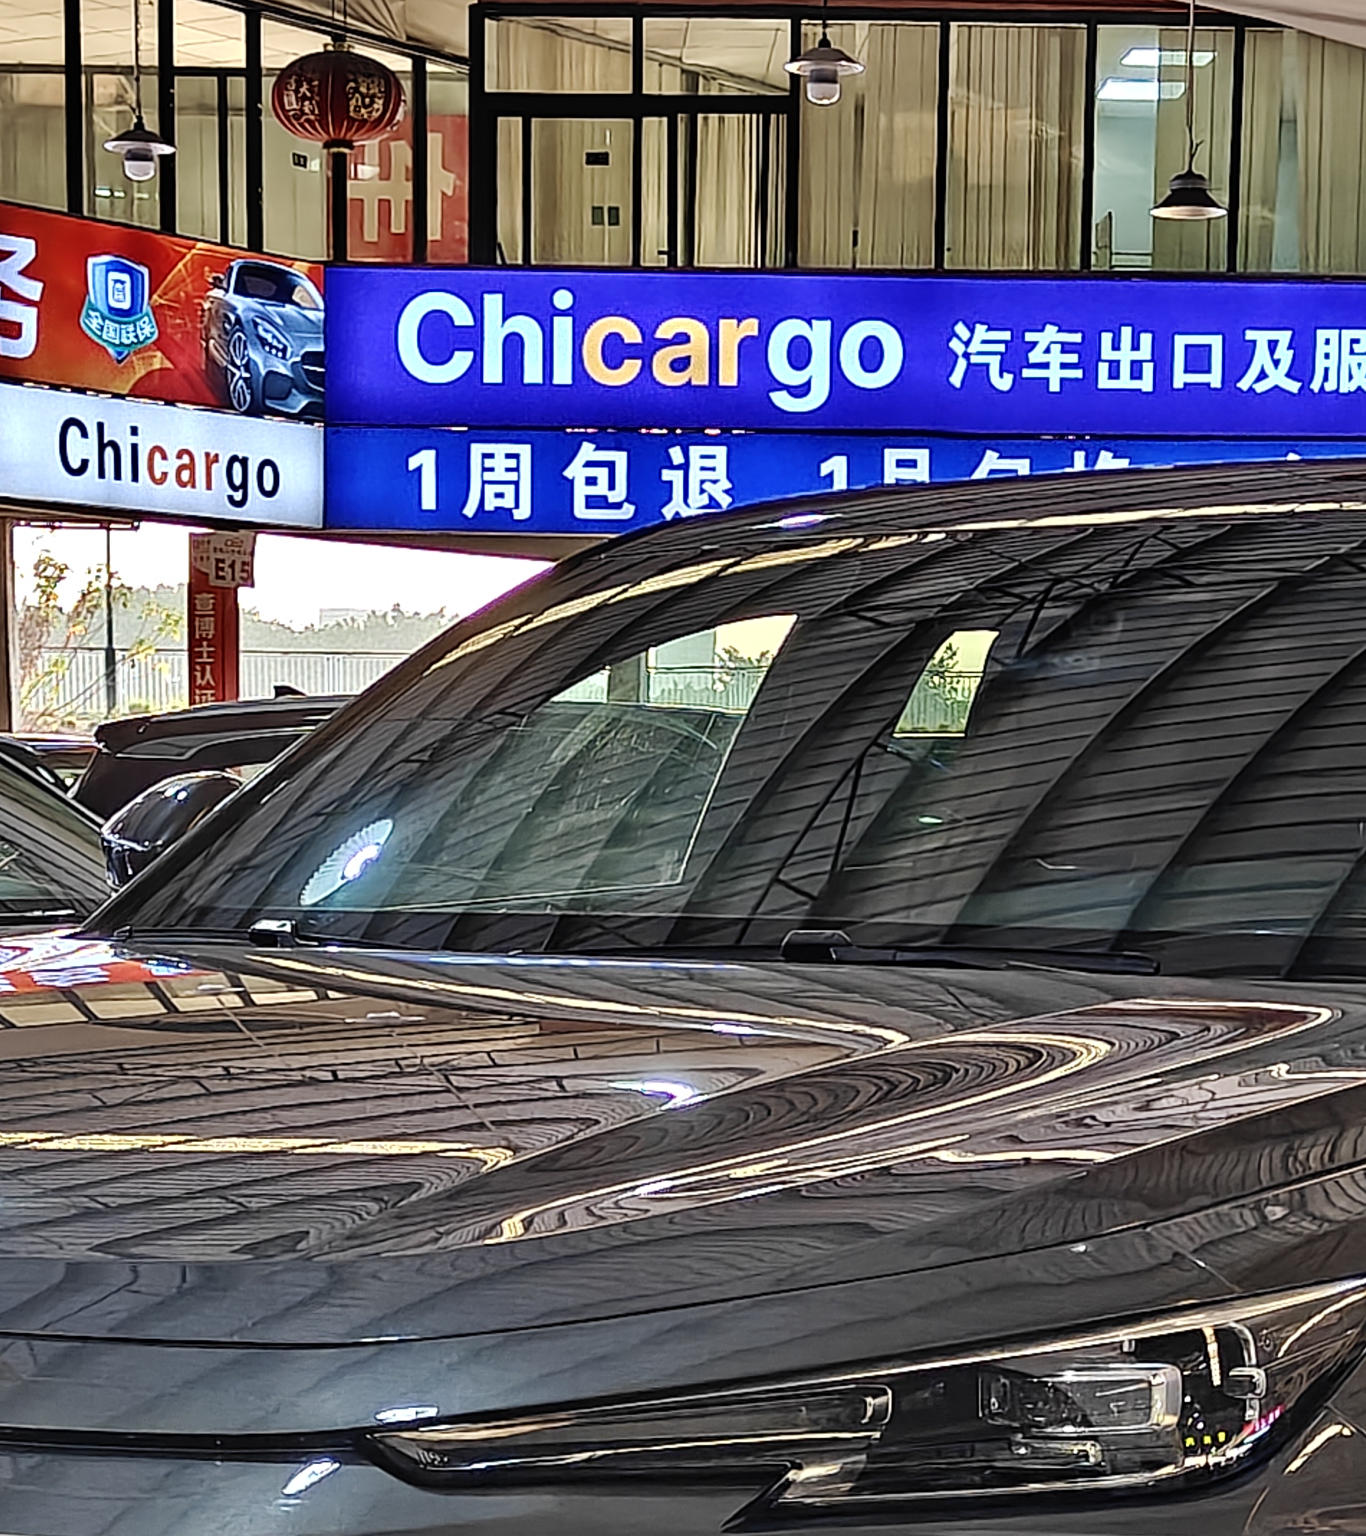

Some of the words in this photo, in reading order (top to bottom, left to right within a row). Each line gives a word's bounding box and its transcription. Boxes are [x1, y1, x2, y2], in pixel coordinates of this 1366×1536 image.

[84, 310, 155, 344] 全国联保
[397, 288, 903, 412] Chicargo
[58, 416, 281, 509] Chicargo
[408, 442, 734, 521] 1周包退
